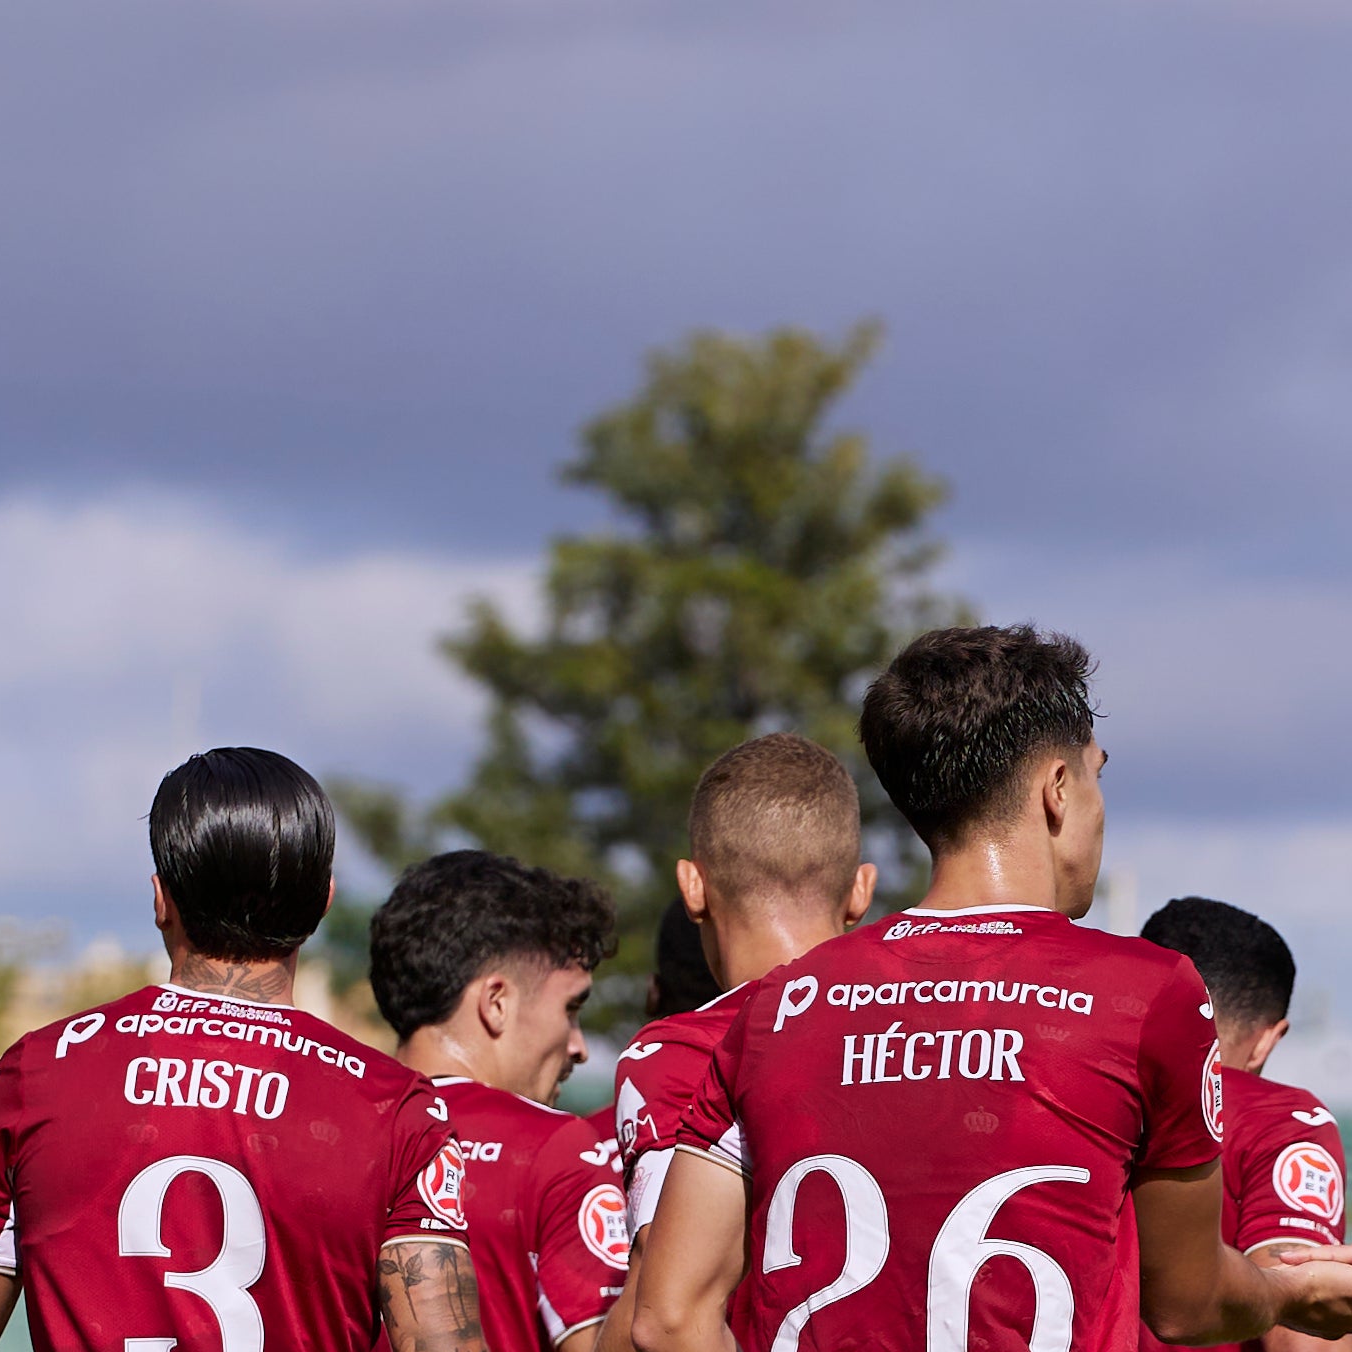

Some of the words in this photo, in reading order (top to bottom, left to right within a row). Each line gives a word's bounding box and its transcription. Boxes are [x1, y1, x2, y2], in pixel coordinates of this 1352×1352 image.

[826, 974, 1094, 1016] aparcamurcia
[115, 1013, 367, 1079] aparcamurcia
[840, 1021, 1026, 1086] HÉCTOR
[123, 1056, 290, 1120] CRISTO
